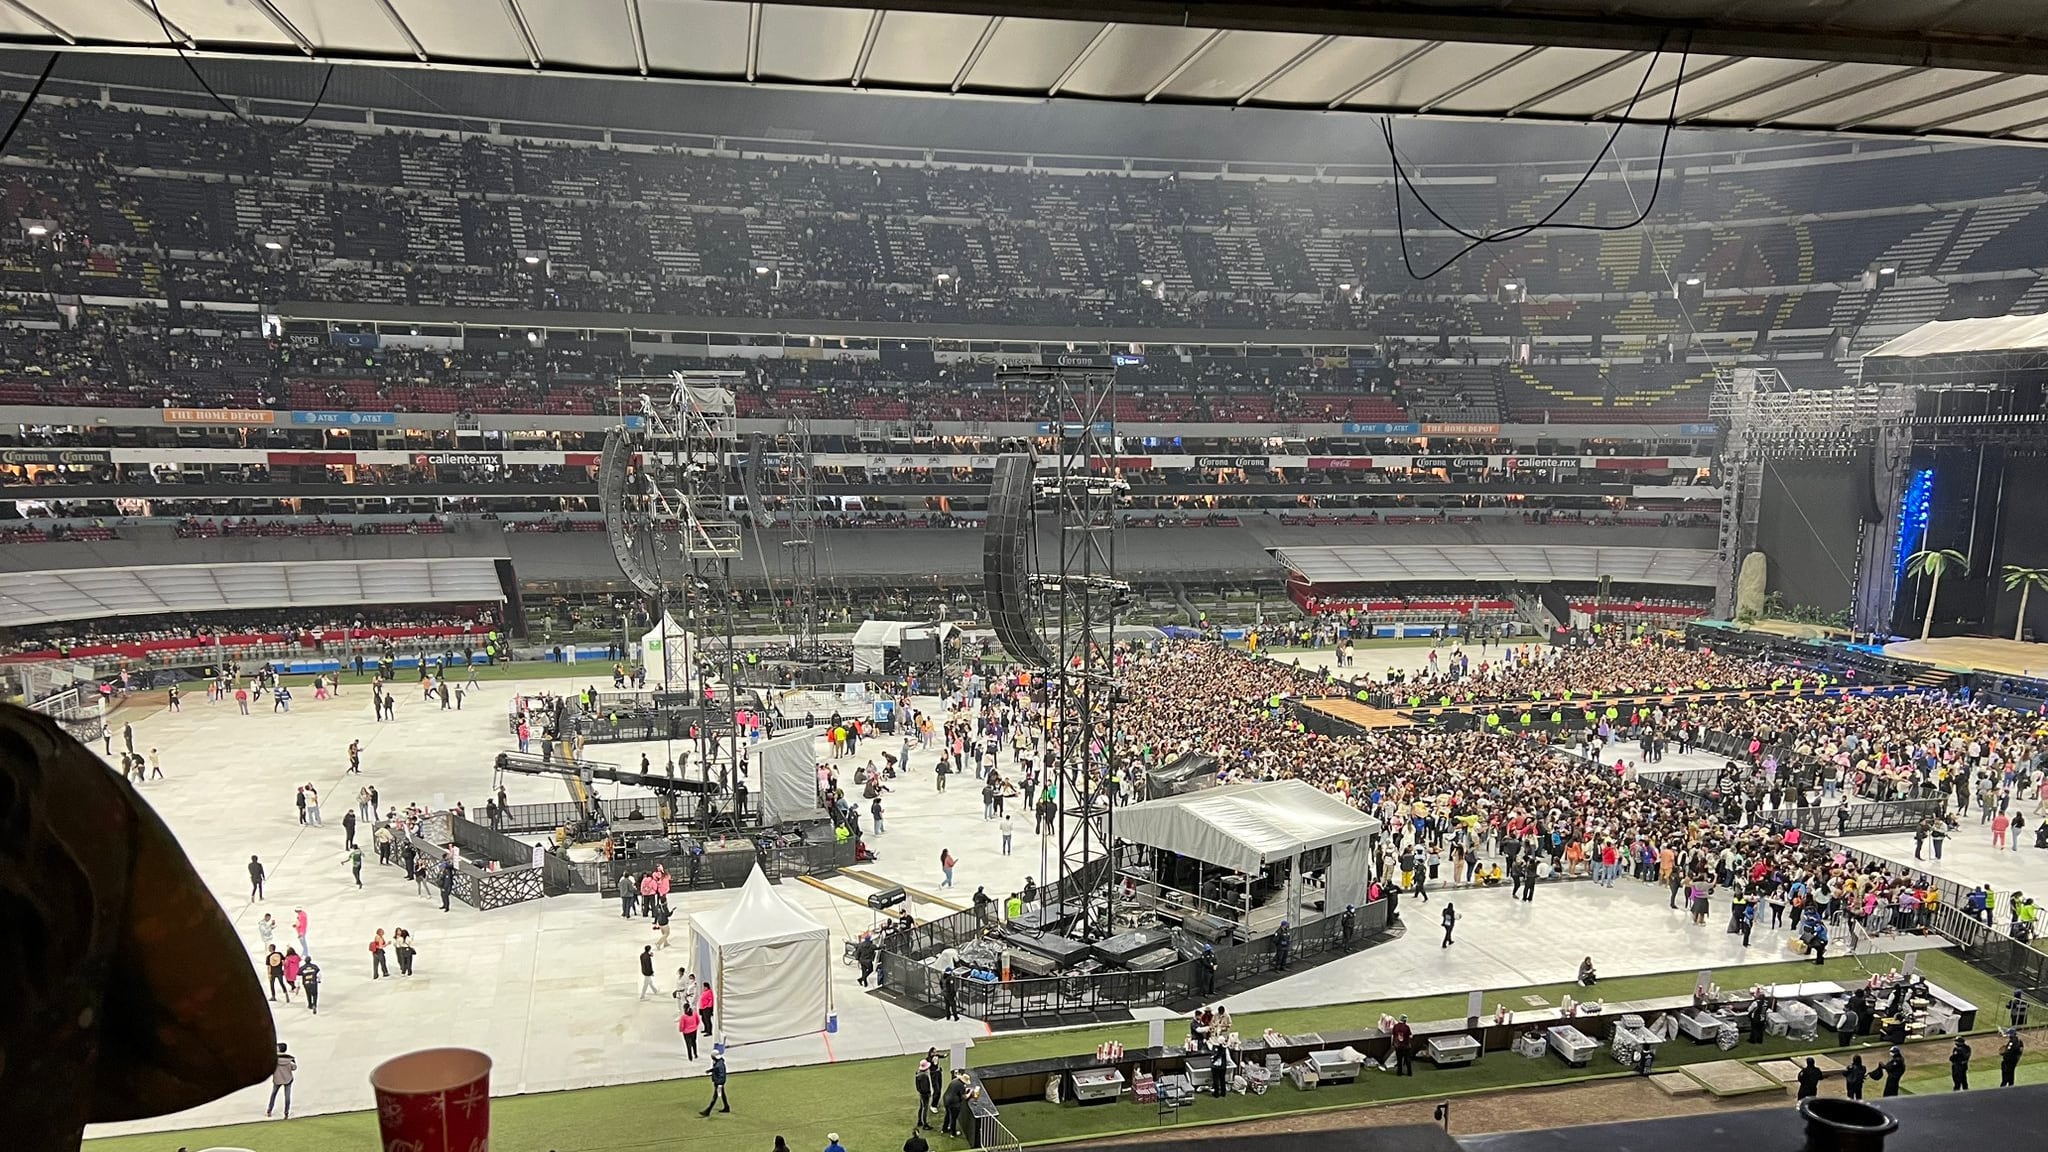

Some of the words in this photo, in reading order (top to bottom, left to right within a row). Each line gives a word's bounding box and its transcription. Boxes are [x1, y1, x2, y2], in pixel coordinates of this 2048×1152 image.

[290, 335, 319, 344] SOCCER
[1058, 354, 1093, 366] Corona
[171, 411, 194, 419] THE
[197, 412, 228, 420] HOME
[230, 412, 266, 421] DEPOT
[361, 415, 381, 423] AT&T
[2, 450, 48, 463] Corona
[60, 450, 104, 464] Corona
[428, 453, 498, 464] caliente.mx
[1199, 457, 1228, 467] Corona
[1235, 457, 1264, 467] Corona
[1517, 457, 1577, 467] caliente.mx
[1416, 457, 1446, 468] Corona
[1453, 457, 1483, 468] Corona
